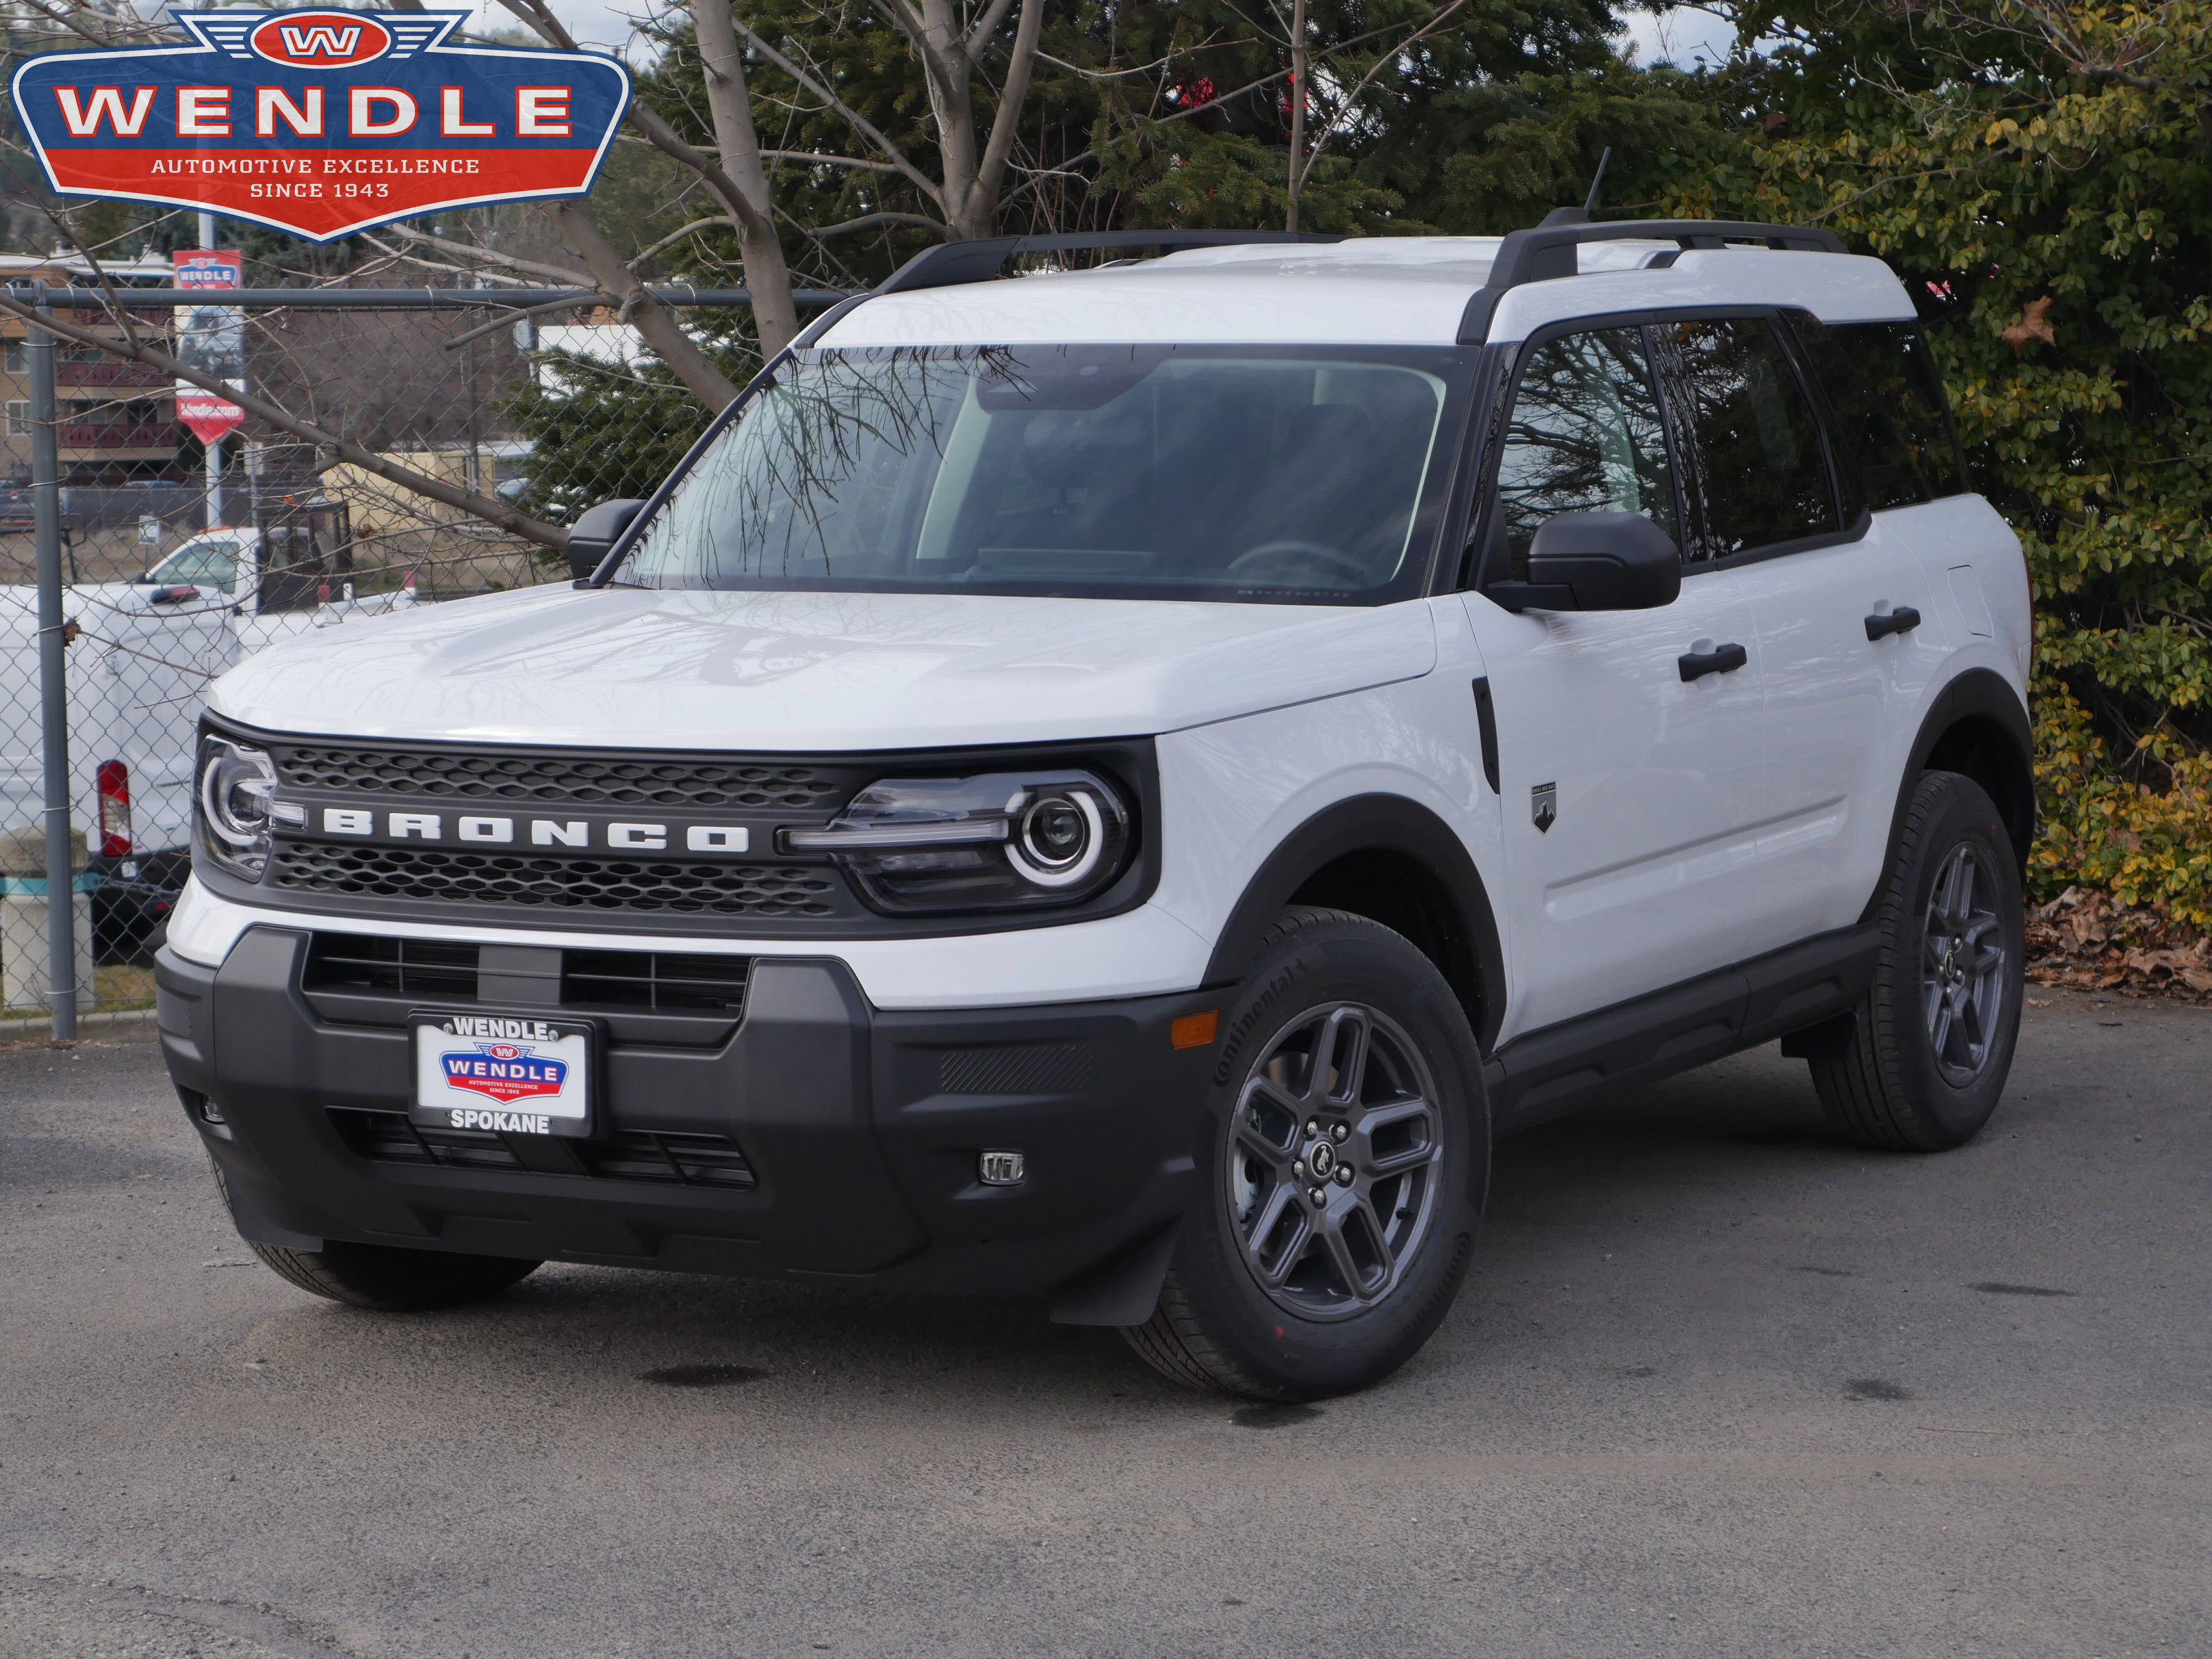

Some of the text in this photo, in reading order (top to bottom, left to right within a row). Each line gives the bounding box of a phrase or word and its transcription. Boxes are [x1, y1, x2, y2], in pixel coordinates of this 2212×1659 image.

[179, 270, 231, 281] WENDLE
[323, 808, 749, 853] BRONCO
[452, 1017, 549, 1041] WENDLE
[448, 1059, 558, 1081] WENDLE
[450, 1109, 549, 1134] SPOKANE
